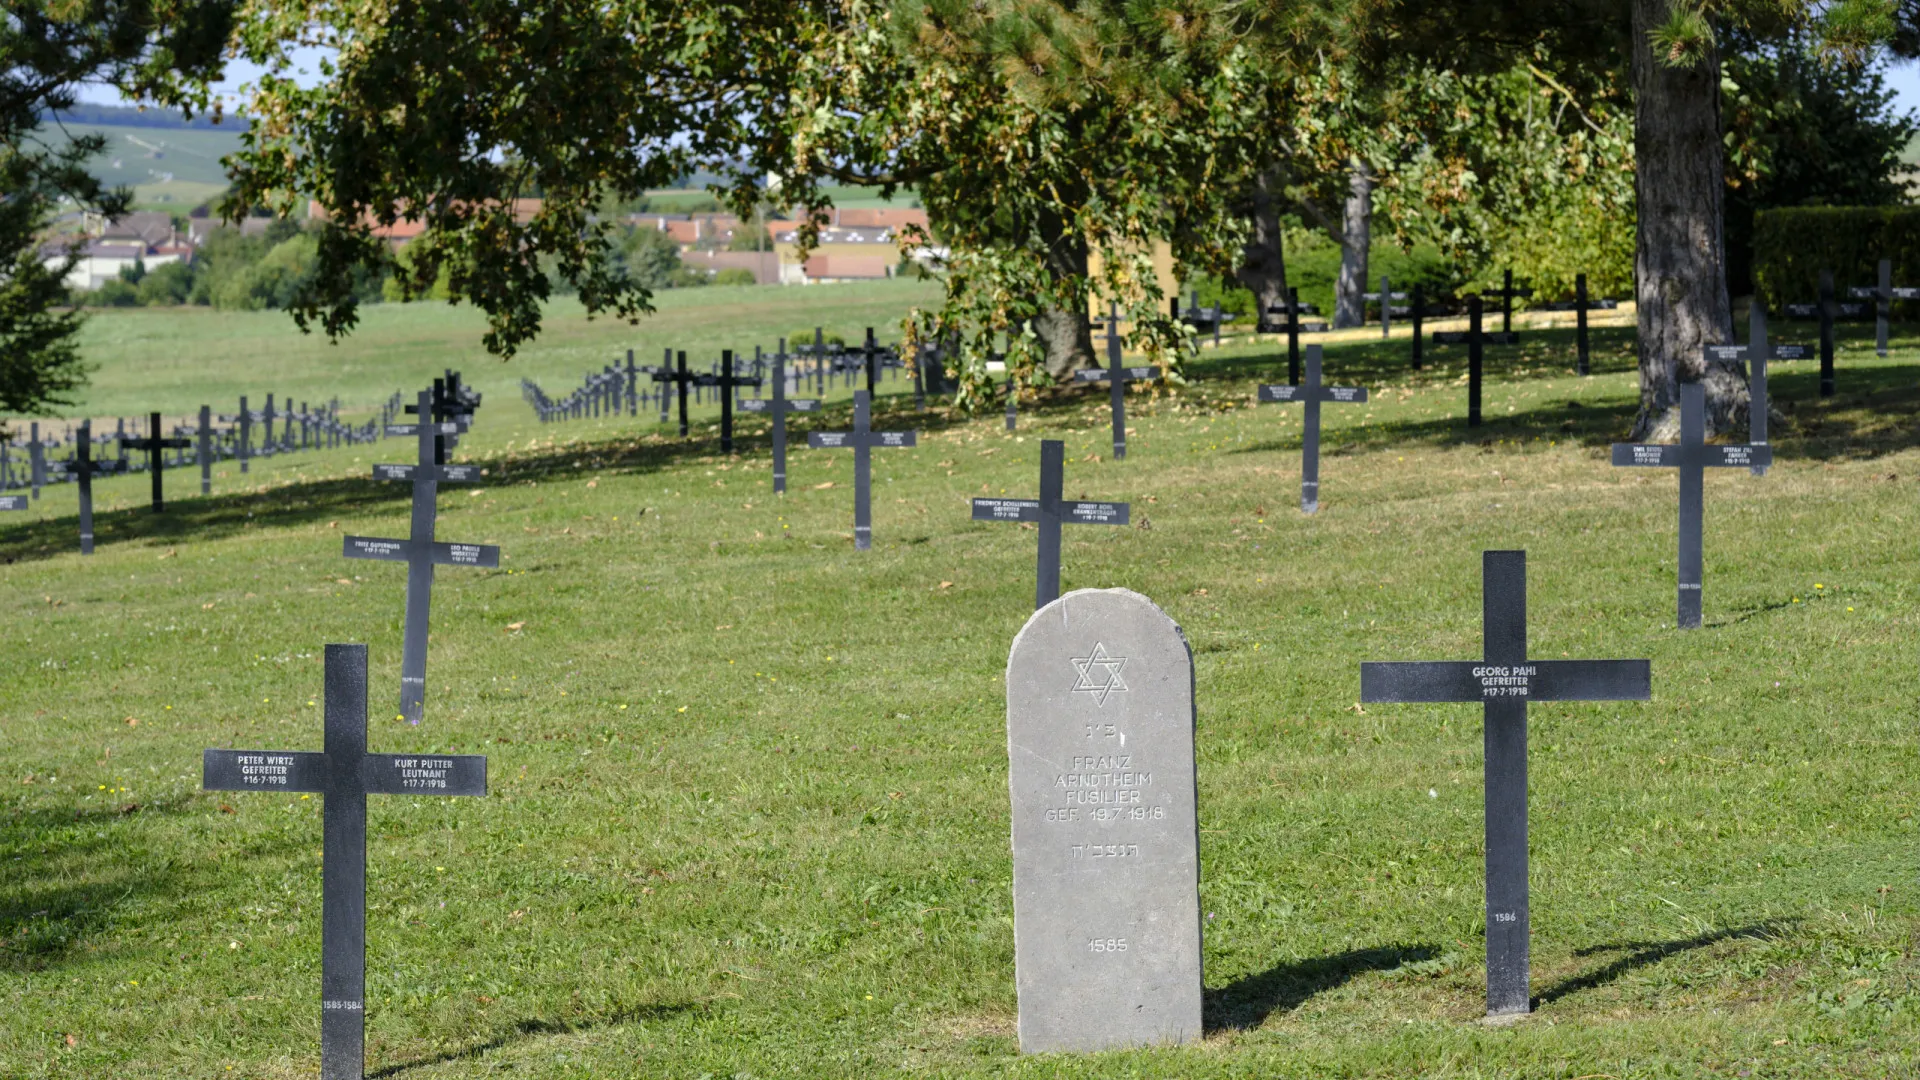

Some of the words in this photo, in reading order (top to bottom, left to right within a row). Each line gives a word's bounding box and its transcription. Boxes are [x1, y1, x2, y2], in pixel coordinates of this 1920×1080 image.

[1472, 666, 1510, 677] GEORG
[1512, 666, 1536, 676] PAHL
[1481, 677, 1528, 686] GEFREITER
[238, 755, 264, 765] PETER
[266, 756, 294, 766] WIRTZ
[394, 759, 418, 768] KURT
[1073, 754, 1132, 769] FRANZ
[242, 765, 288, 775] GEFREITER
[402, 769, 447, 778] LEUTNANT
[1054, 771, 1152, 788] ARNDTHEIM
[1045, 807, 1080, 822] GEF.
[1495, 911, 1516, 922] 1586
[1087, 937, 1128, 952] 1585
